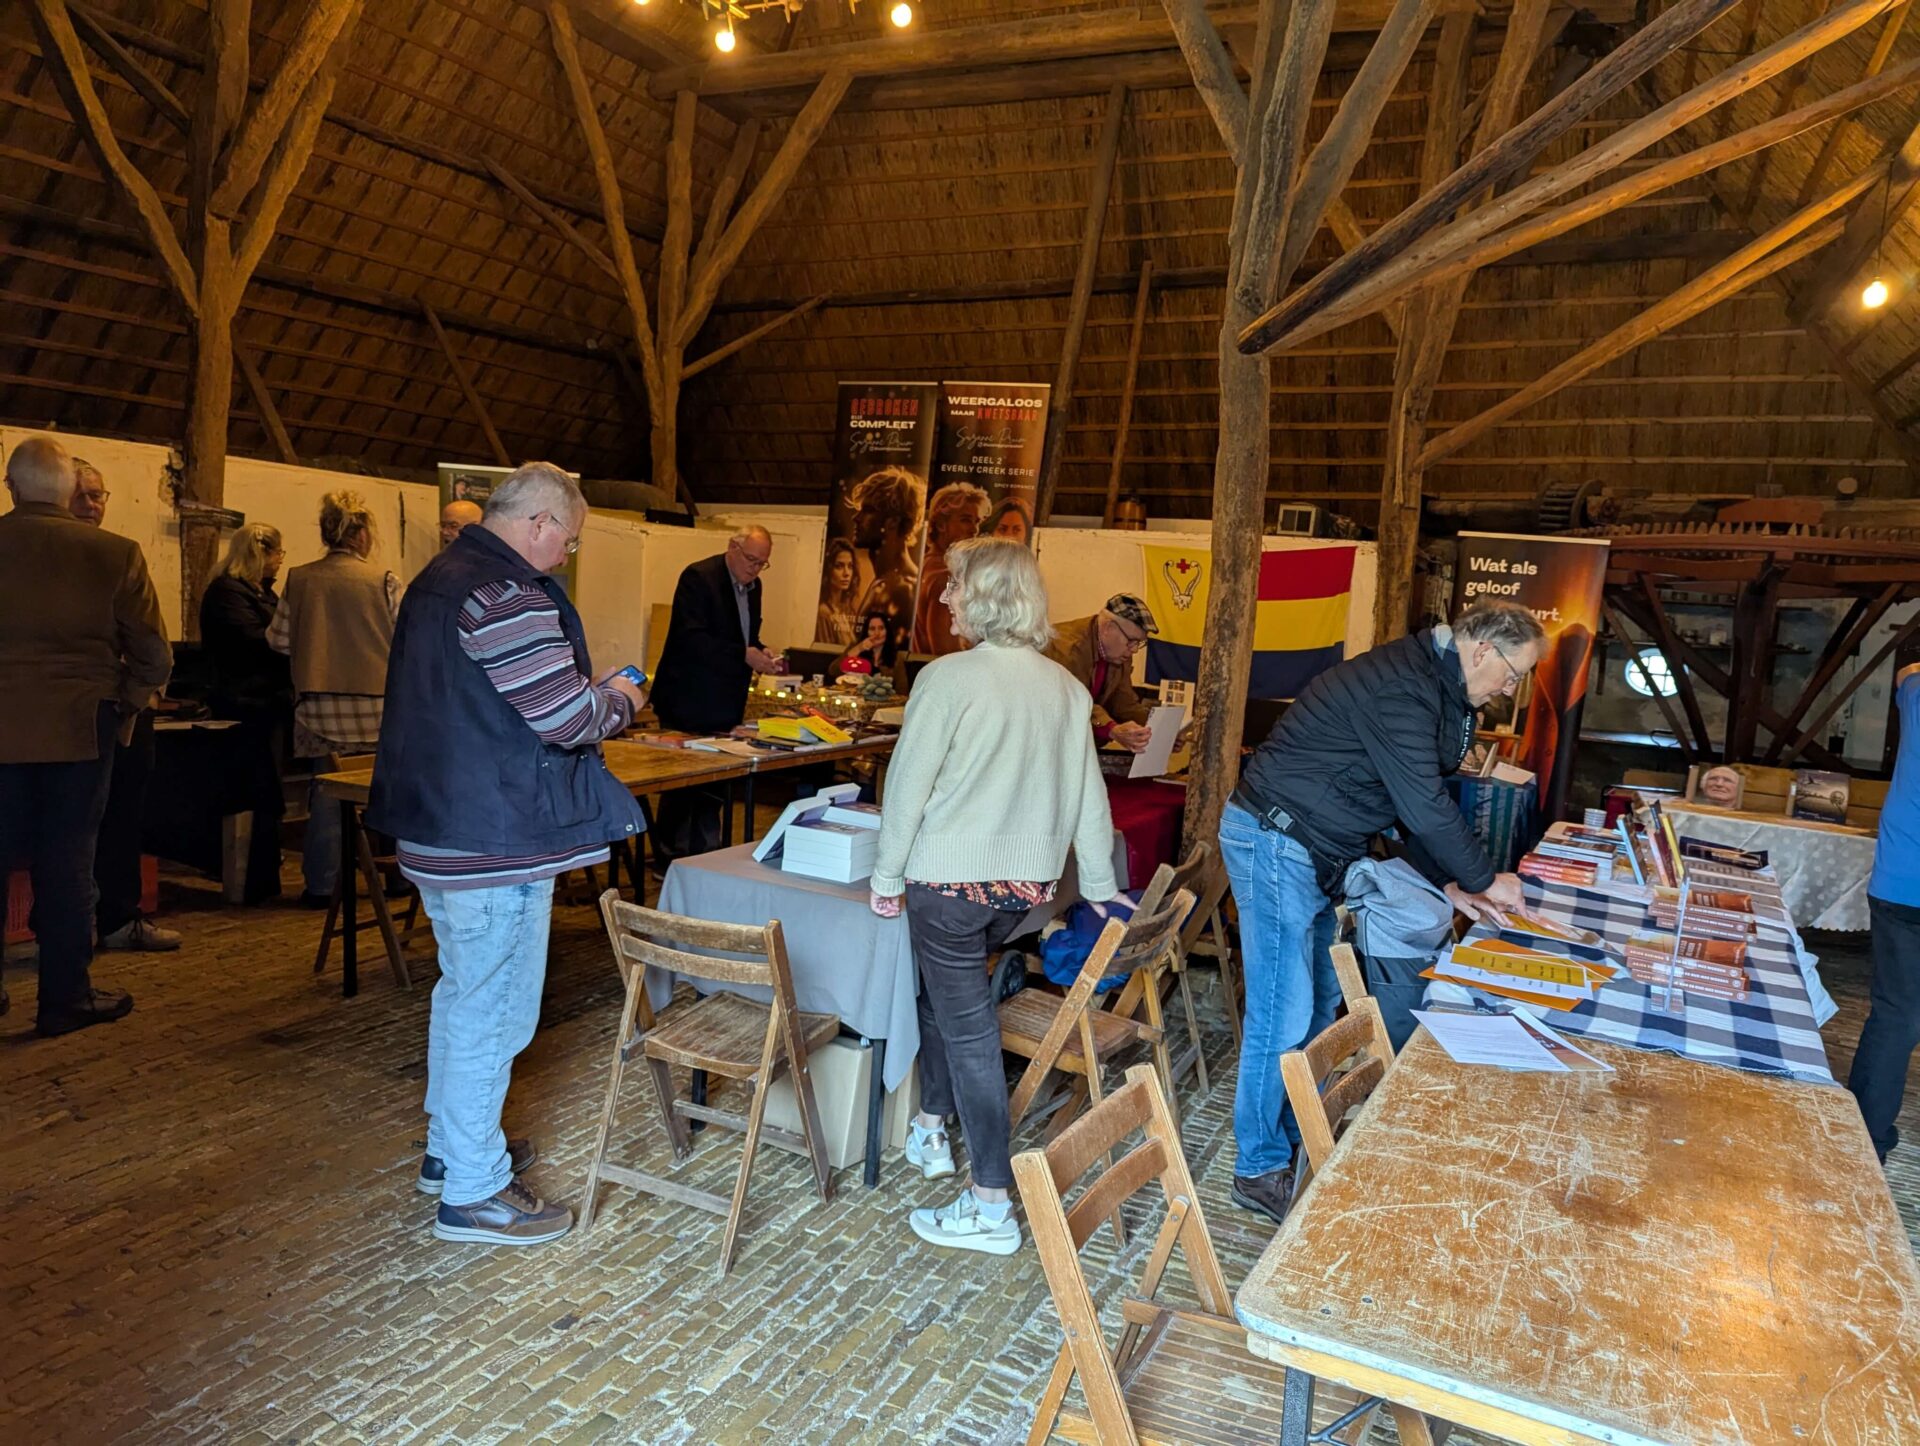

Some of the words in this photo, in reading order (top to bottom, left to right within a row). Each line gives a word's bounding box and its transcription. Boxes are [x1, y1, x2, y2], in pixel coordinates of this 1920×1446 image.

[947, 396, 1043, 408] WEERGALOOS
[977, 407, 1038, 421] KWETSBAAR
[849, 420, 916, 430] COMPLEET
[971, 456, 995, 464] DEEL
[996, 457, 1003, 465] 2
[940, 463, 975, 473] EVERLY
[976, 466, 1006, 476] CREEK
[1008, 468, 1035, 477] SERIE
[1470, 557, 1508, 573] Wat
[1511, 561, 1538, 575] als
[1464, 580, 1521, 596] geloof
